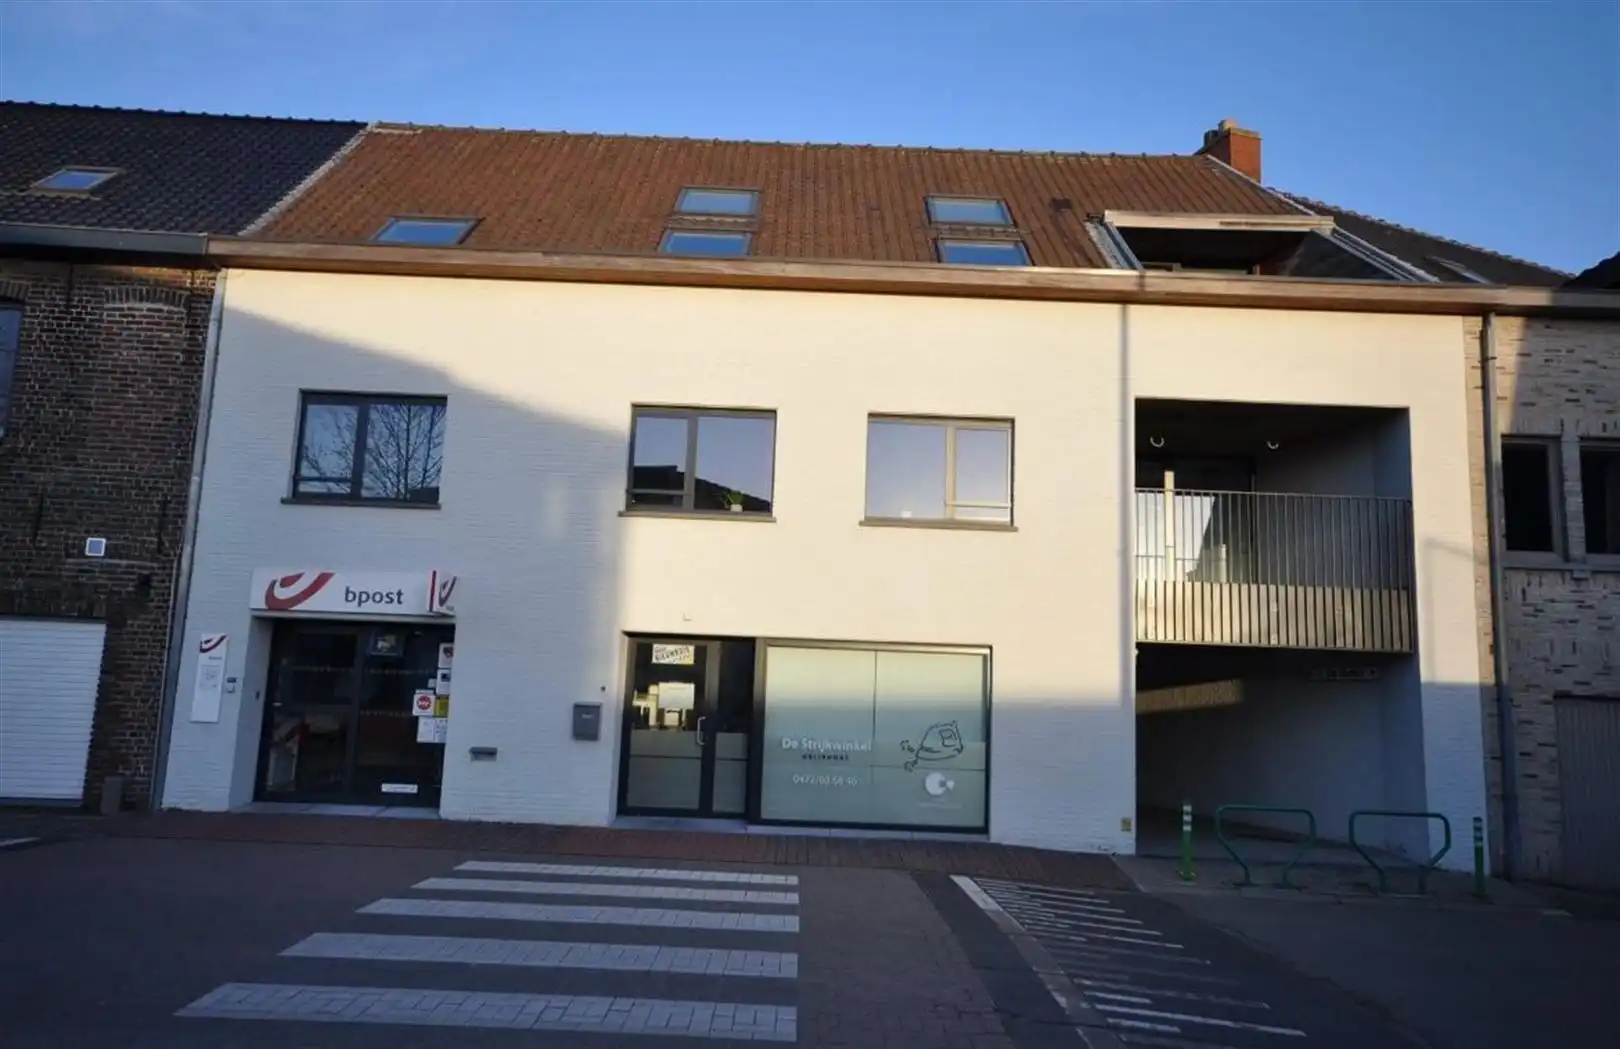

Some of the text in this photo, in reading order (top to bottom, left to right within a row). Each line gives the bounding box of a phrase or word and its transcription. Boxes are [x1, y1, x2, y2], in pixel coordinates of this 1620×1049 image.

[344, 586, 404, 607] bpost
[781, 737, 872, 753] De Strijkwinkel
